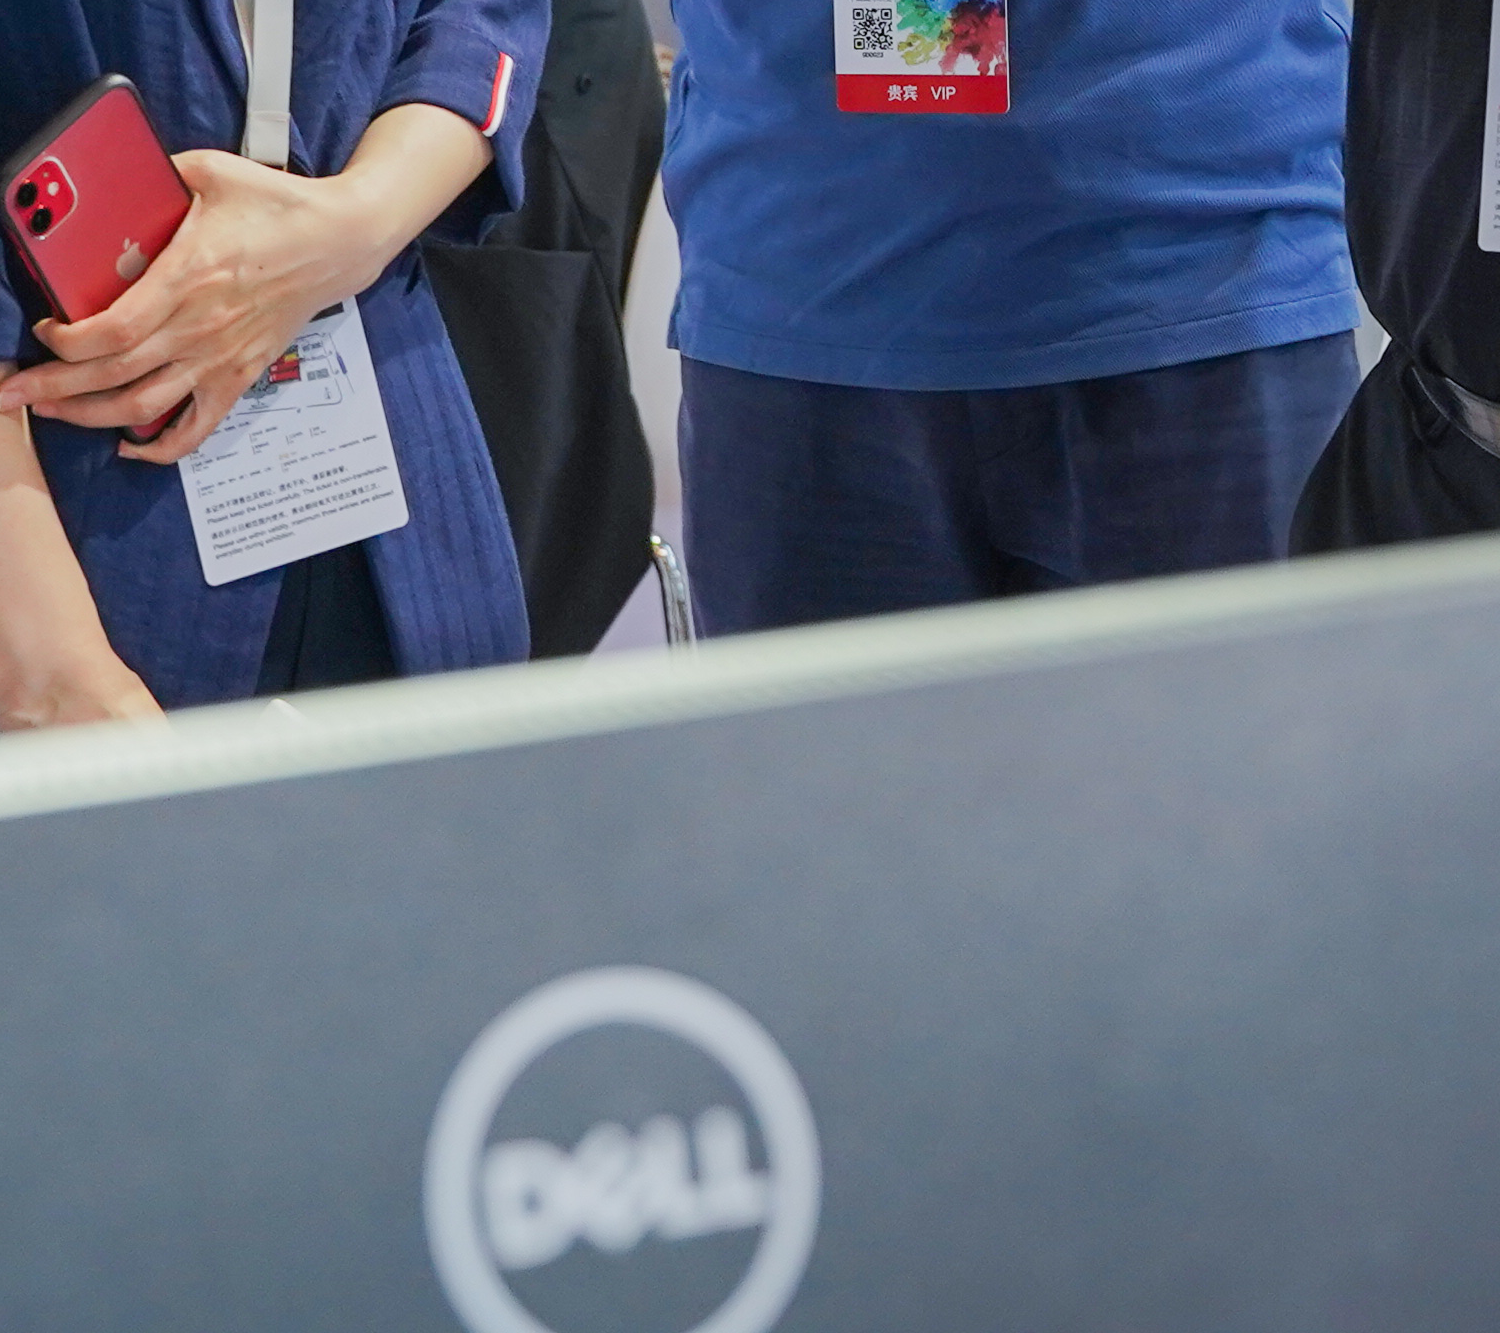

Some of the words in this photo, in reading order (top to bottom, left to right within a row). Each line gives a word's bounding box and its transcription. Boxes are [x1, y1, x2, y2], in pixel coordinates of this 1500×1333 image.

[887, 84, 918, 101] 贵宾
[931, 86, 956, 100] VIP
[483, 1103, 772, 1273] DELL
